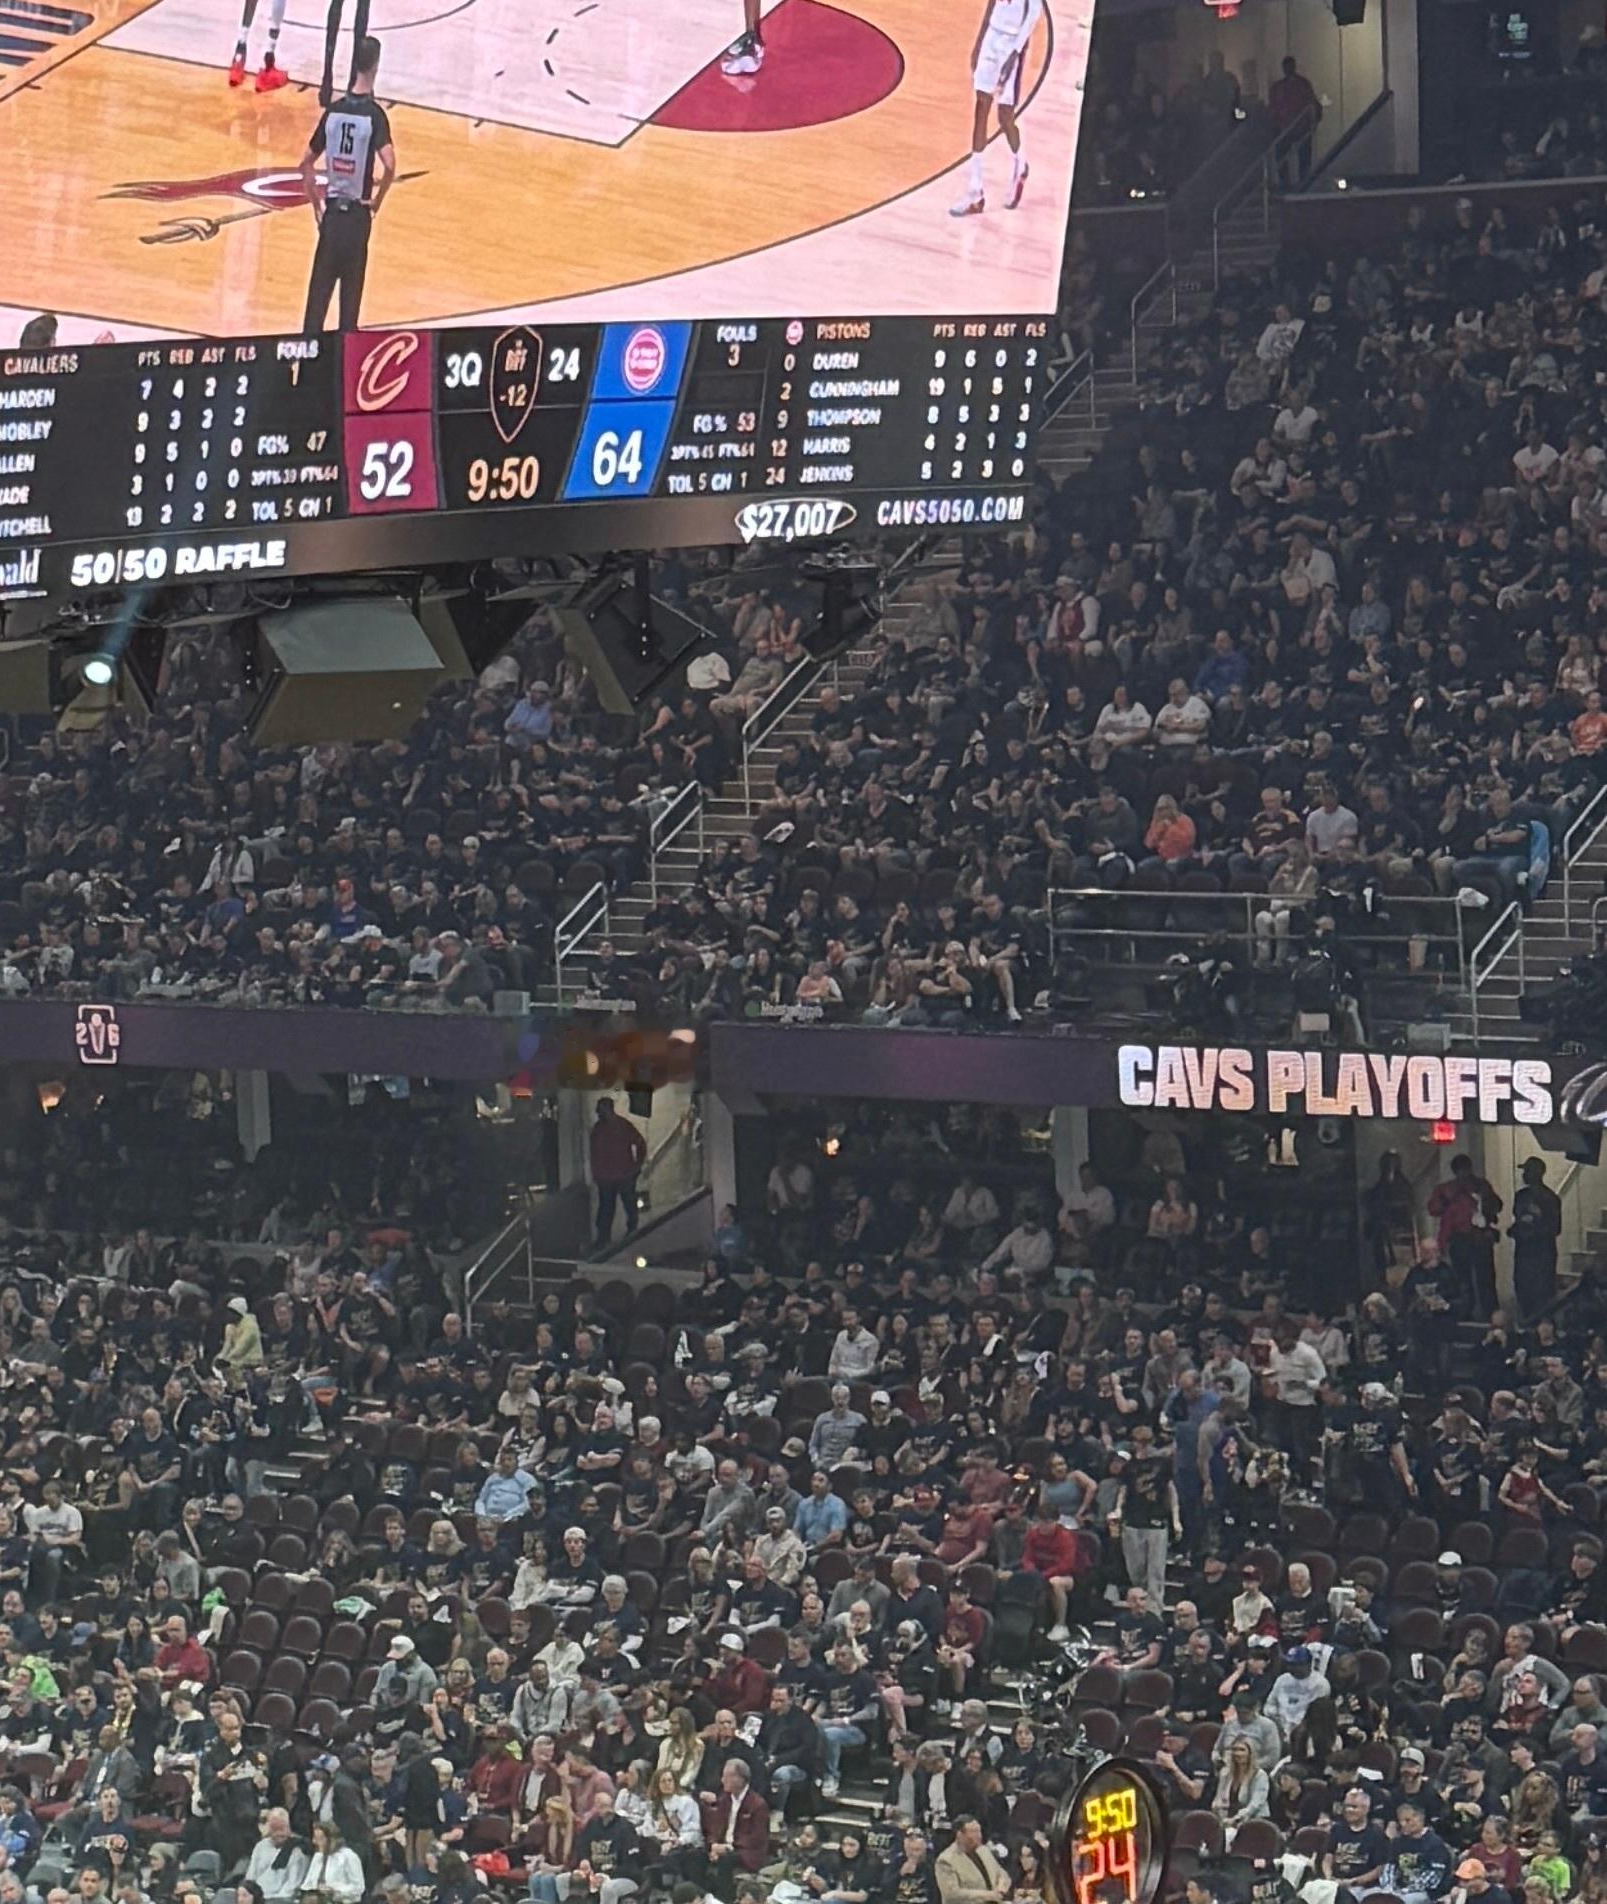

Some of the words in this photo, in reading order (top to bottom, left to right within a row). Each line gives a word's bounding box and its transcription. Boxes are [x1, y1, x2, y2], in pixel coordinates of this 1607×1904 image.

[339, 120, 353, 156] 15
[716, 324, 757, 344] FOULS
[817, 321, 871, 340] PISTONS
[4, 353, 78, 376] CAVALIERS
[444, 352, 482, 389] 3Q
[547, 347, 581, 382] 24
[727, 344, 740, 367] 3
[813, 351, 859, 371] DUREN
[996, 348, 1007, 368] 0
[1025, 348, 1037, 367] 2
[172, 378, 185, 399] 4
[807, 408, 881, 427] THOMPSON
[307, 430, 327, 452] 47
[771, 438, 788, 457] 12
[360, 440, 414, 500] 52
[593, 429, 644, 486] 64
[468, 455, 539, 502] 9:50
[252, 500, 278, 521] TOL
[741, 501, 840, 543] $27,007
[877, 495, 1024, 527] CAVS5050.COM
[70, 549, 166, 588] 50/50
[174, 539, 286, 576] RAFFLE
[1117, 1044, 1256, 1112] CAVS
[1267, 1049, 1554, 1125] PLAYOFFS
[1085, 1788, 1138, 1838] 9:50
